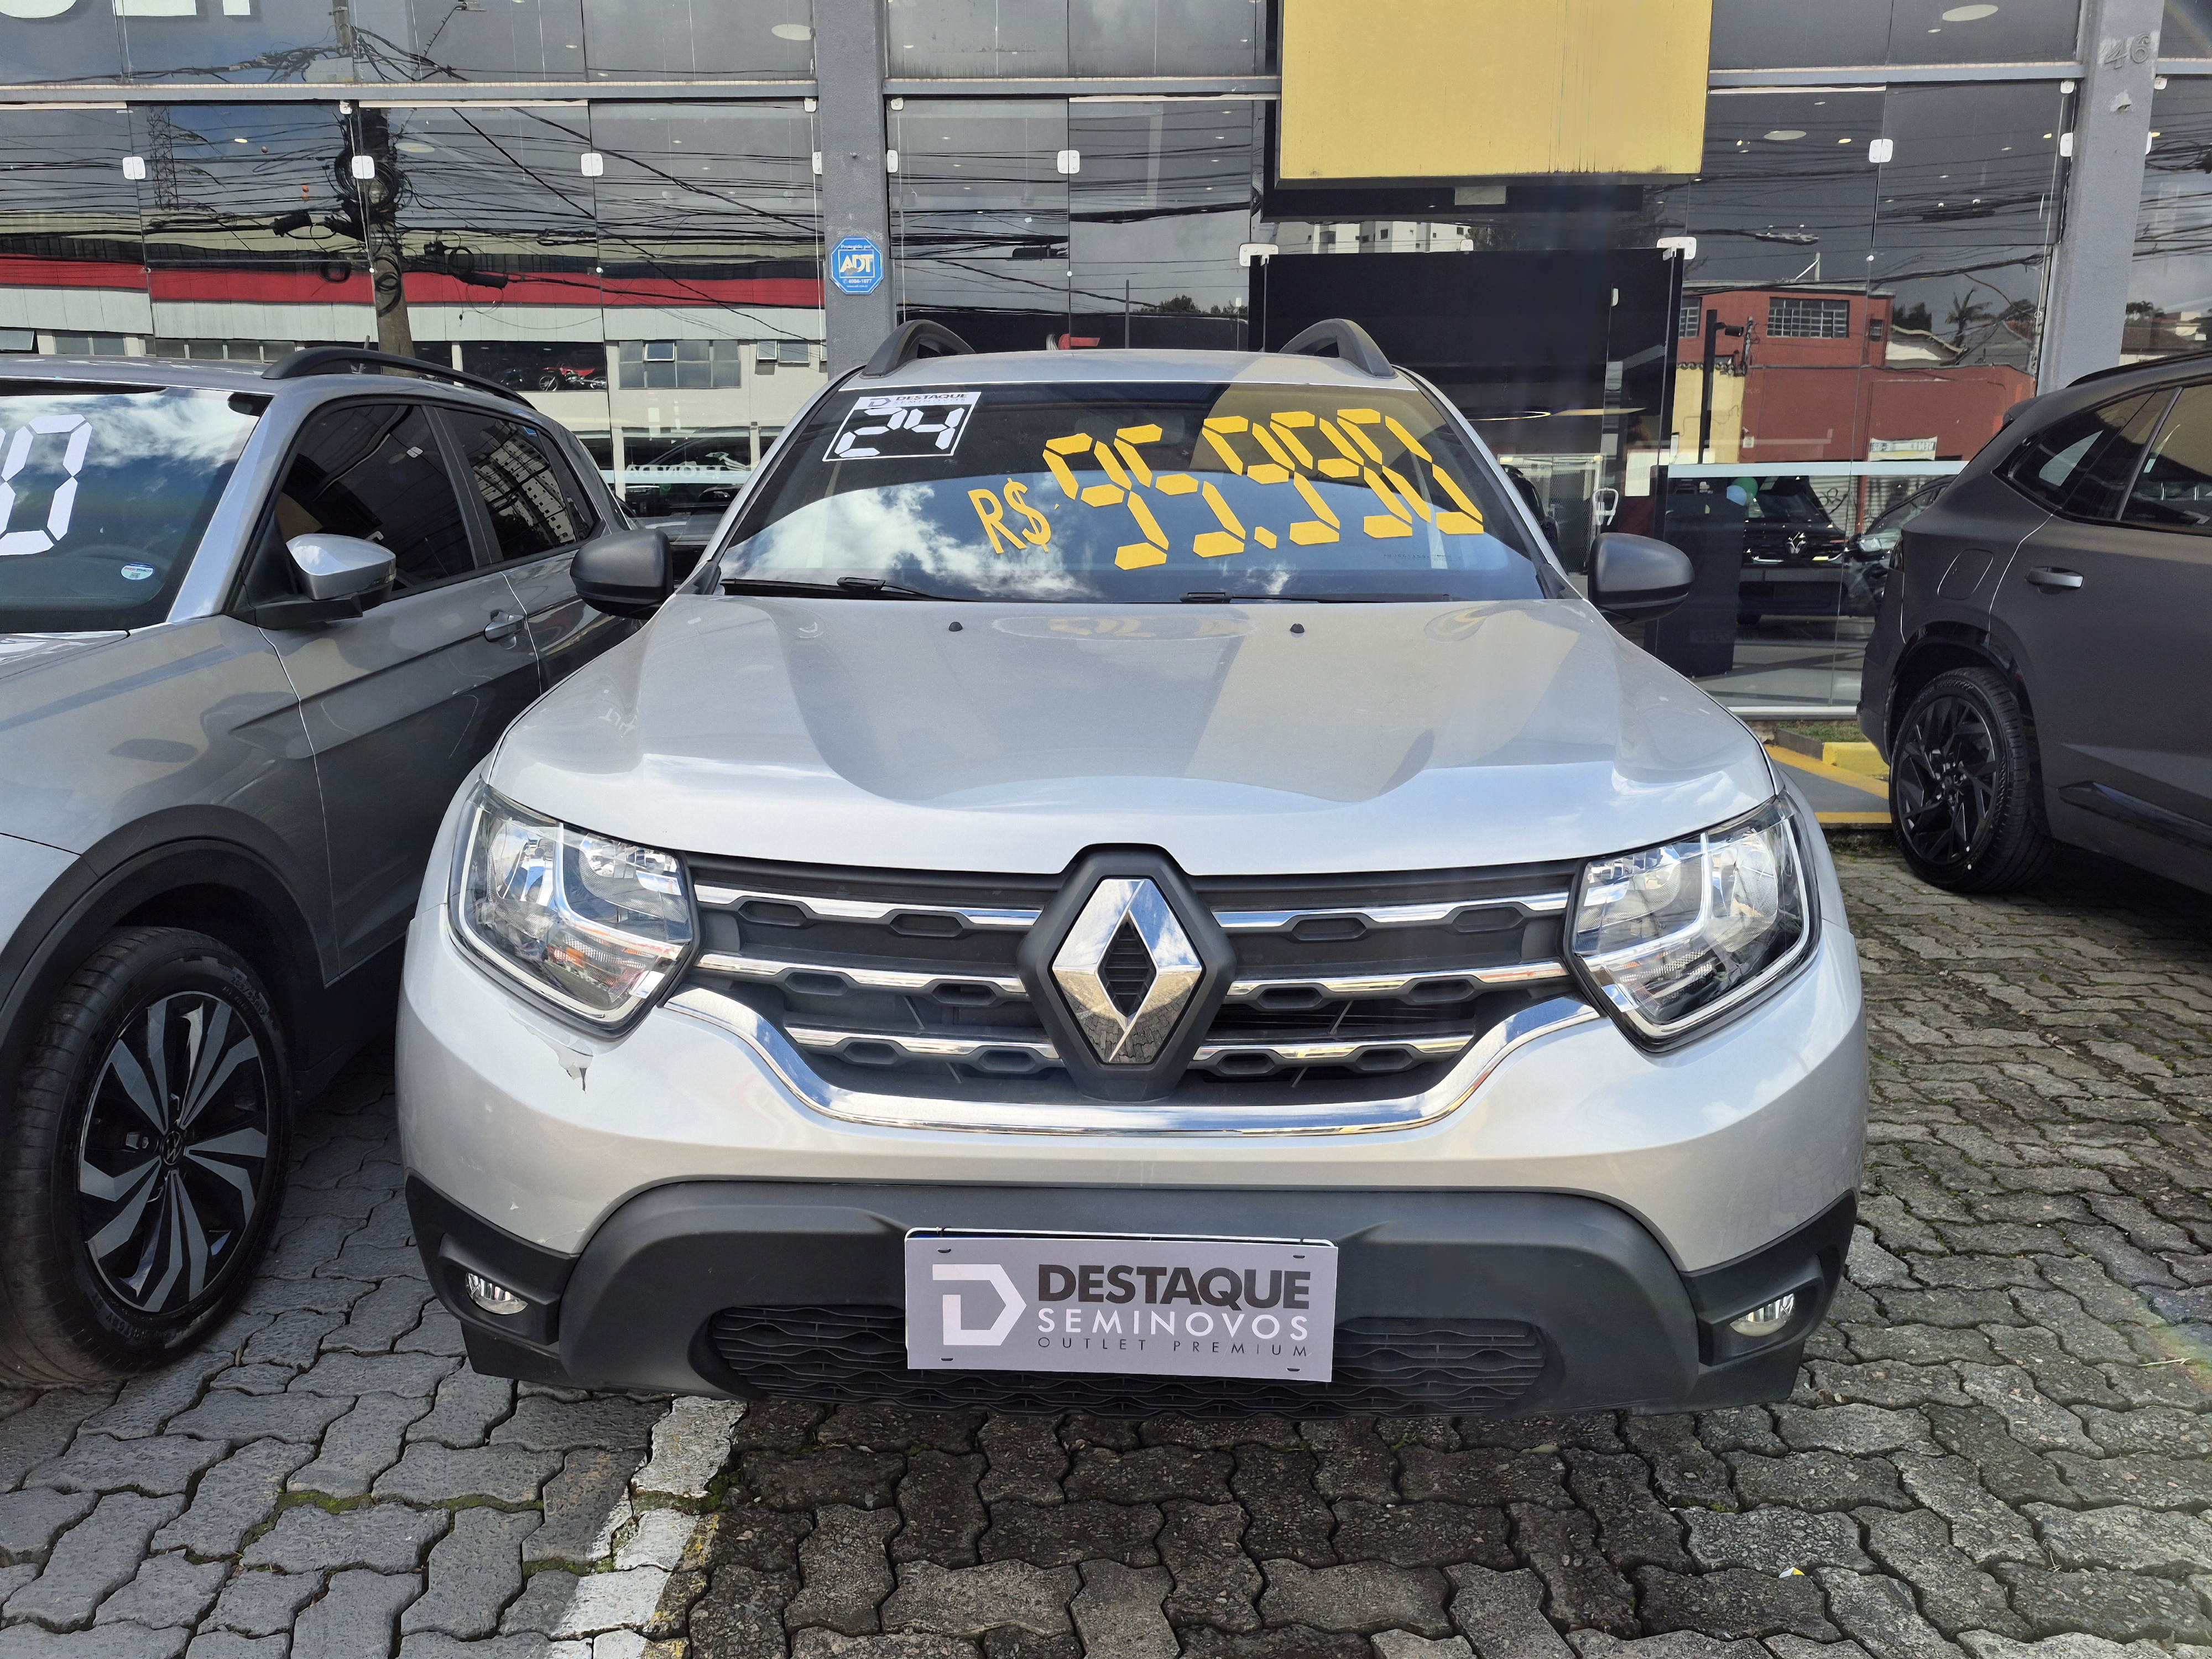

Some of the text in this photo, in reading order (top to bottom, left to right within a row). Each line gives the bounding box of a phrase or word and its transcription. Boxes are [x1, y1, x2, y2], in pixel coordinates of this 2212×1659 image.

[840, 254, 874, 273] ADT
[834, 407, 965, 458] 24
[968, 408, 1484, 570] R$ 95.990
[1038, 1264, 1311, 1311] DESTAQUE
[1037, 1308, 1308, 1342] SEMINOVOS
[1038, 1337, 1308, 1358] OUTLET PREMIUM
